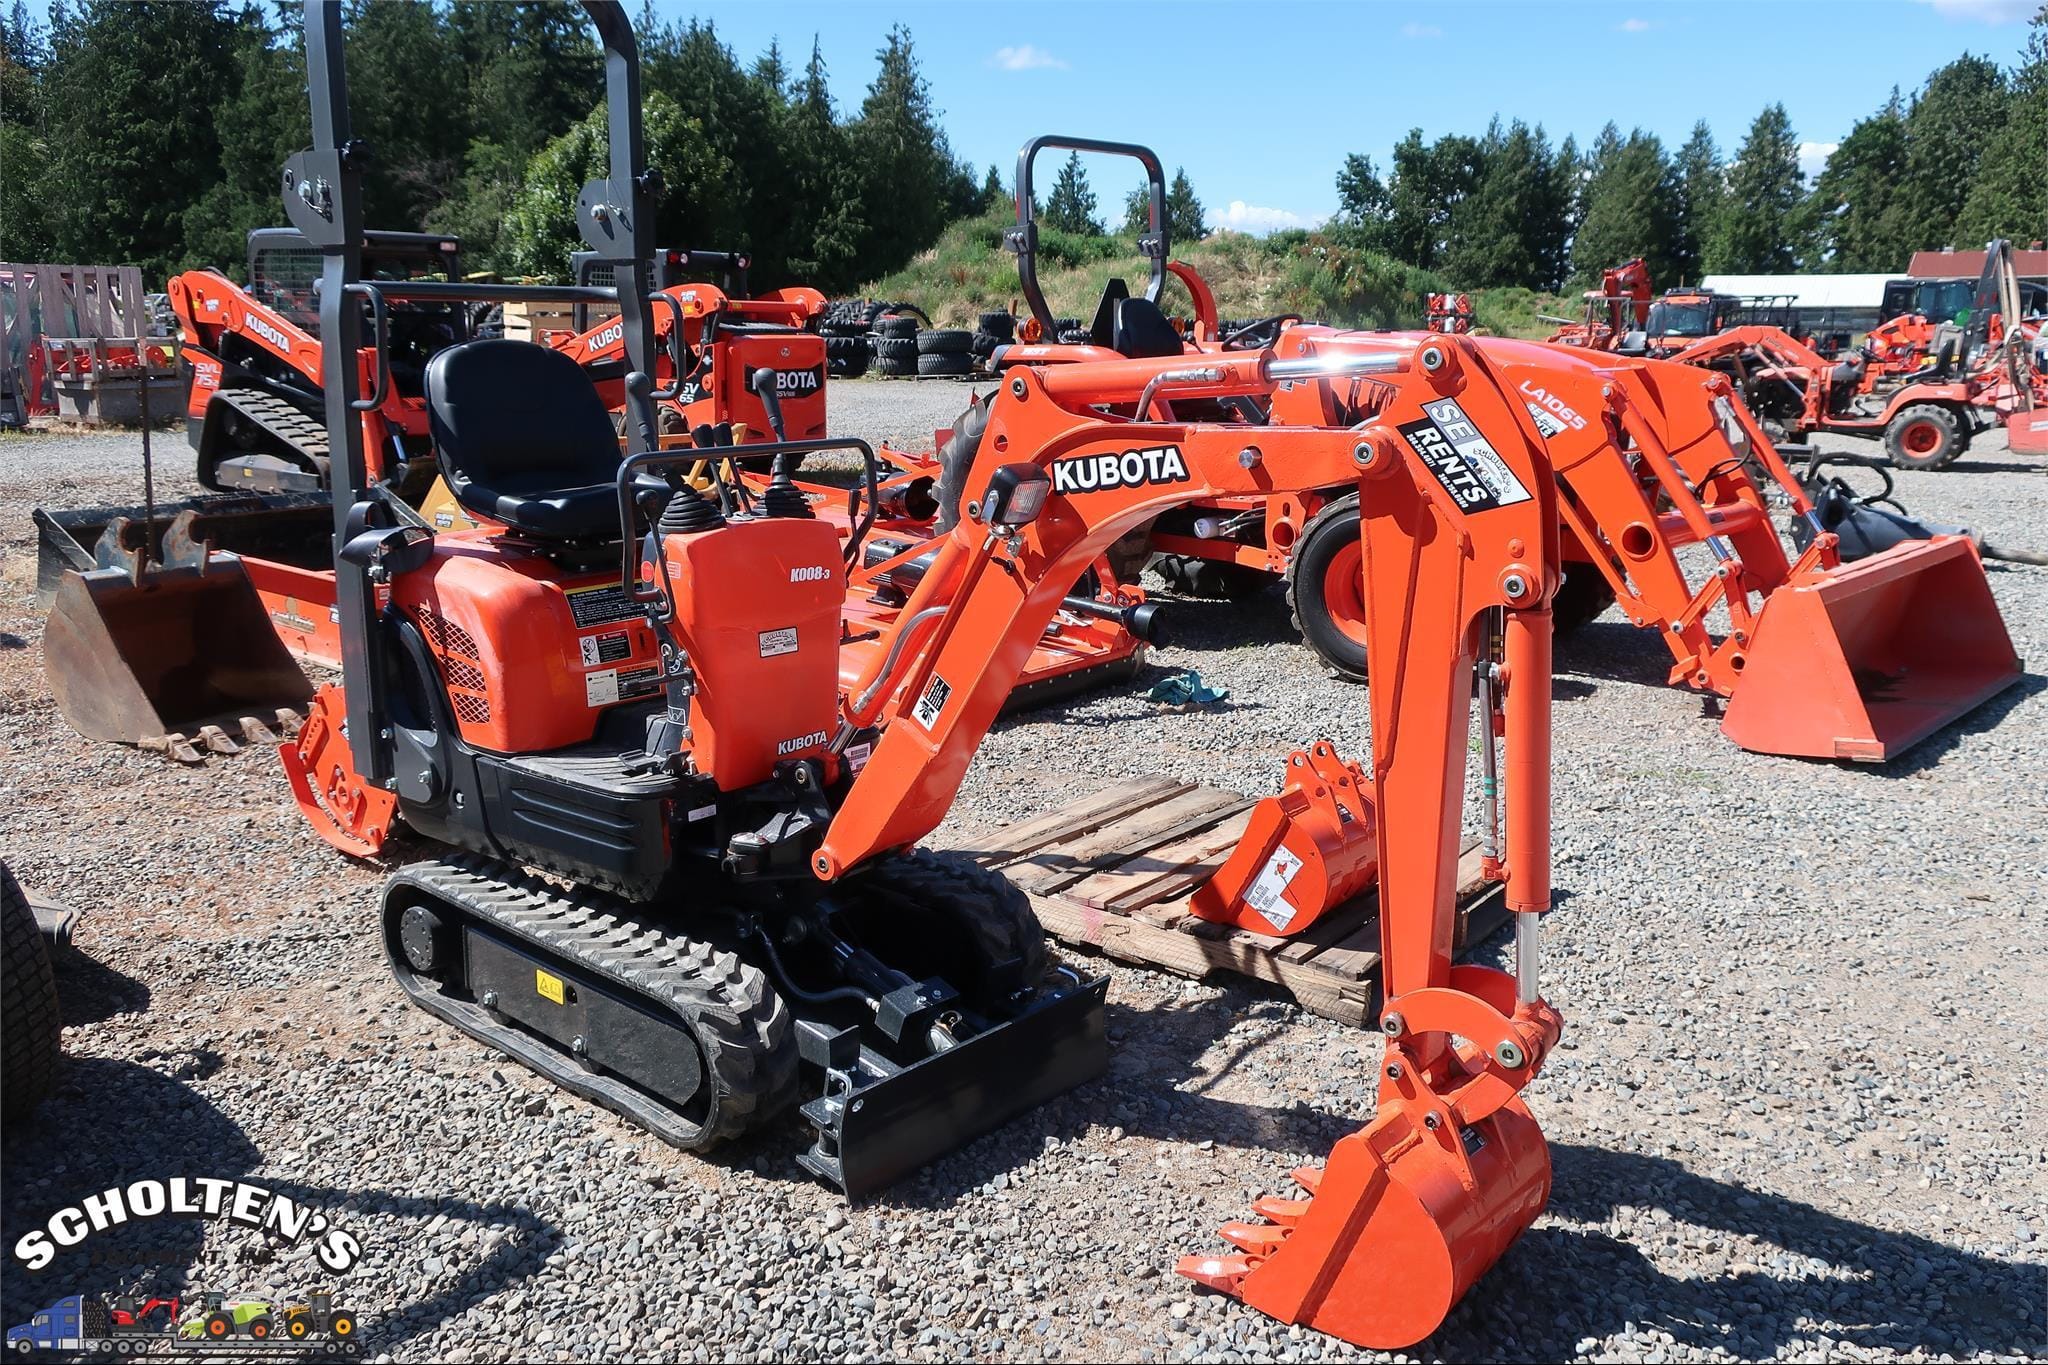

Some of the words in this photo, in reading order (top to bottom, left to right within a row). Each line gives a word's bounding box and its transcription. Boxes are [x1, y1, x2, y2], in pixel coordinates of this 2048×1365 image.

[245, 312, 290, 353] KUBOTA
[588, 322, 624, 353] KUBO
[752, 371, 817, 390] BOTA
[679, 393, 695, 403] 65
[1520, 379, 1588, 431] LA1065
[1430, 403, 1476, 441] SE
[1053, 447, 1186, 491] KUBOTA
[1414, 427, 1488, 503] RENTS
[790, 566, 831, 583] K008-3
[777, 730, 828, 755] KUBOTA
